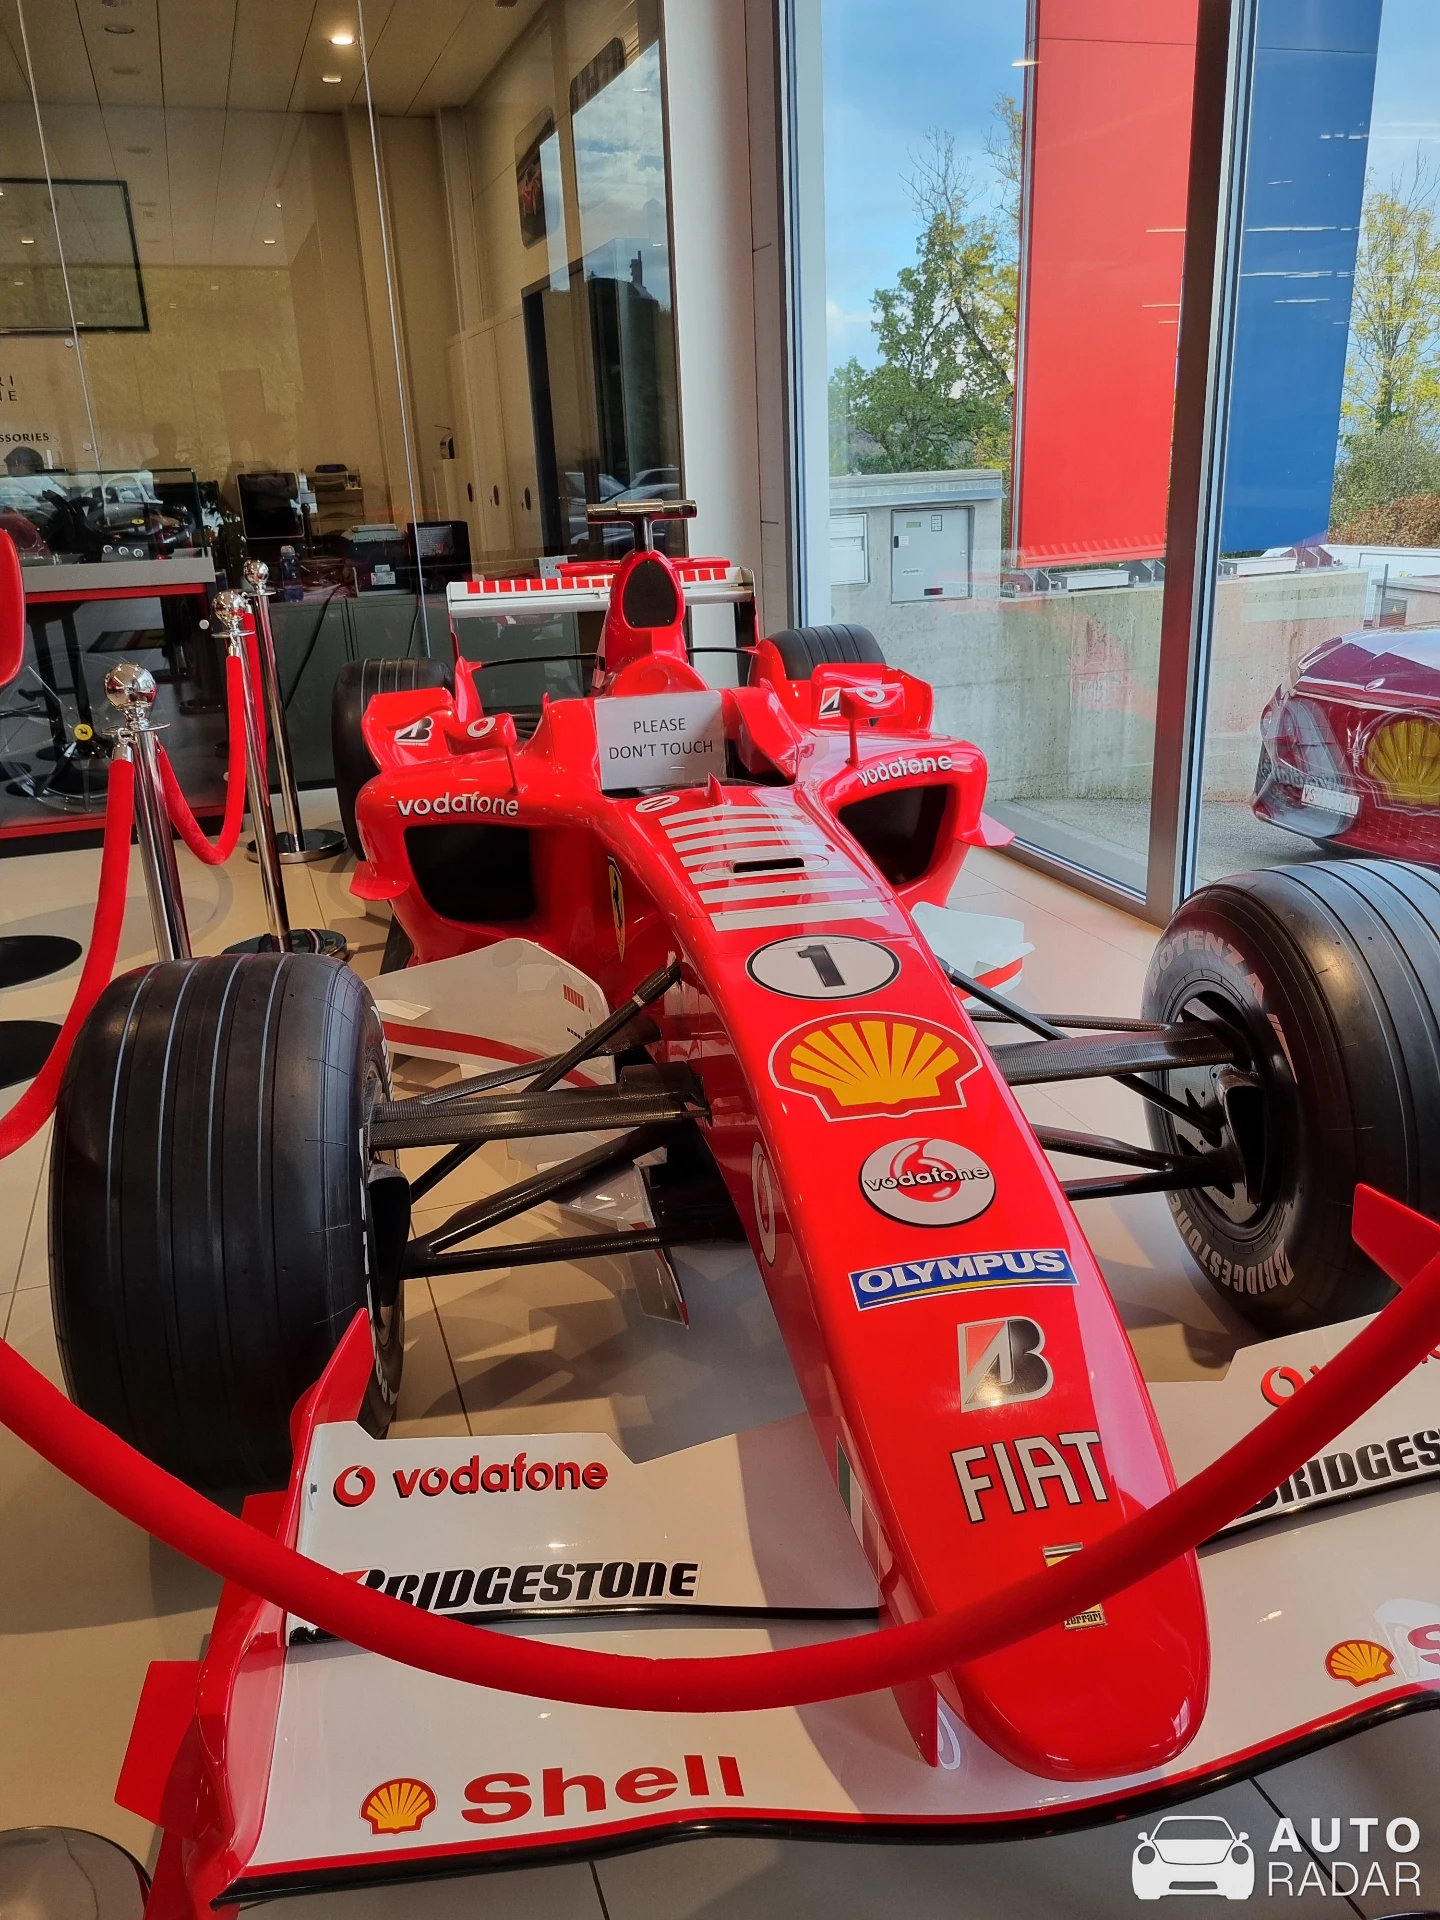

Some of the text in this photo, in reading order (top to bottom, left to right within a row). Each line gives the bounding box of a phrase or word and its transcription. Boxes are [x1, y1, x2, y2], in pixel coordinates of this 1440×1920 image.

[632, 717, 687, 734] PLEASE
[608, 739, 713, 760] DON'T TOUCH
[856, 754, 953, 788] vodafone
[396, 790, 520, 818] vodafone
[795, 943, 847, 988] 1
[1149, 930, 1264, 1009] POTENZA
[863, 1164, 990, 1193] vodafone
[857, 1250, 1066, 1295] OLYMPUS
[392, 1452, 609, 1498] vodafone
[951, 1430, 1110, 1525] FIAT
[1235, 1428, 1440, 1520] RIDGES
[460, 1754, 745, 1825] Shell
